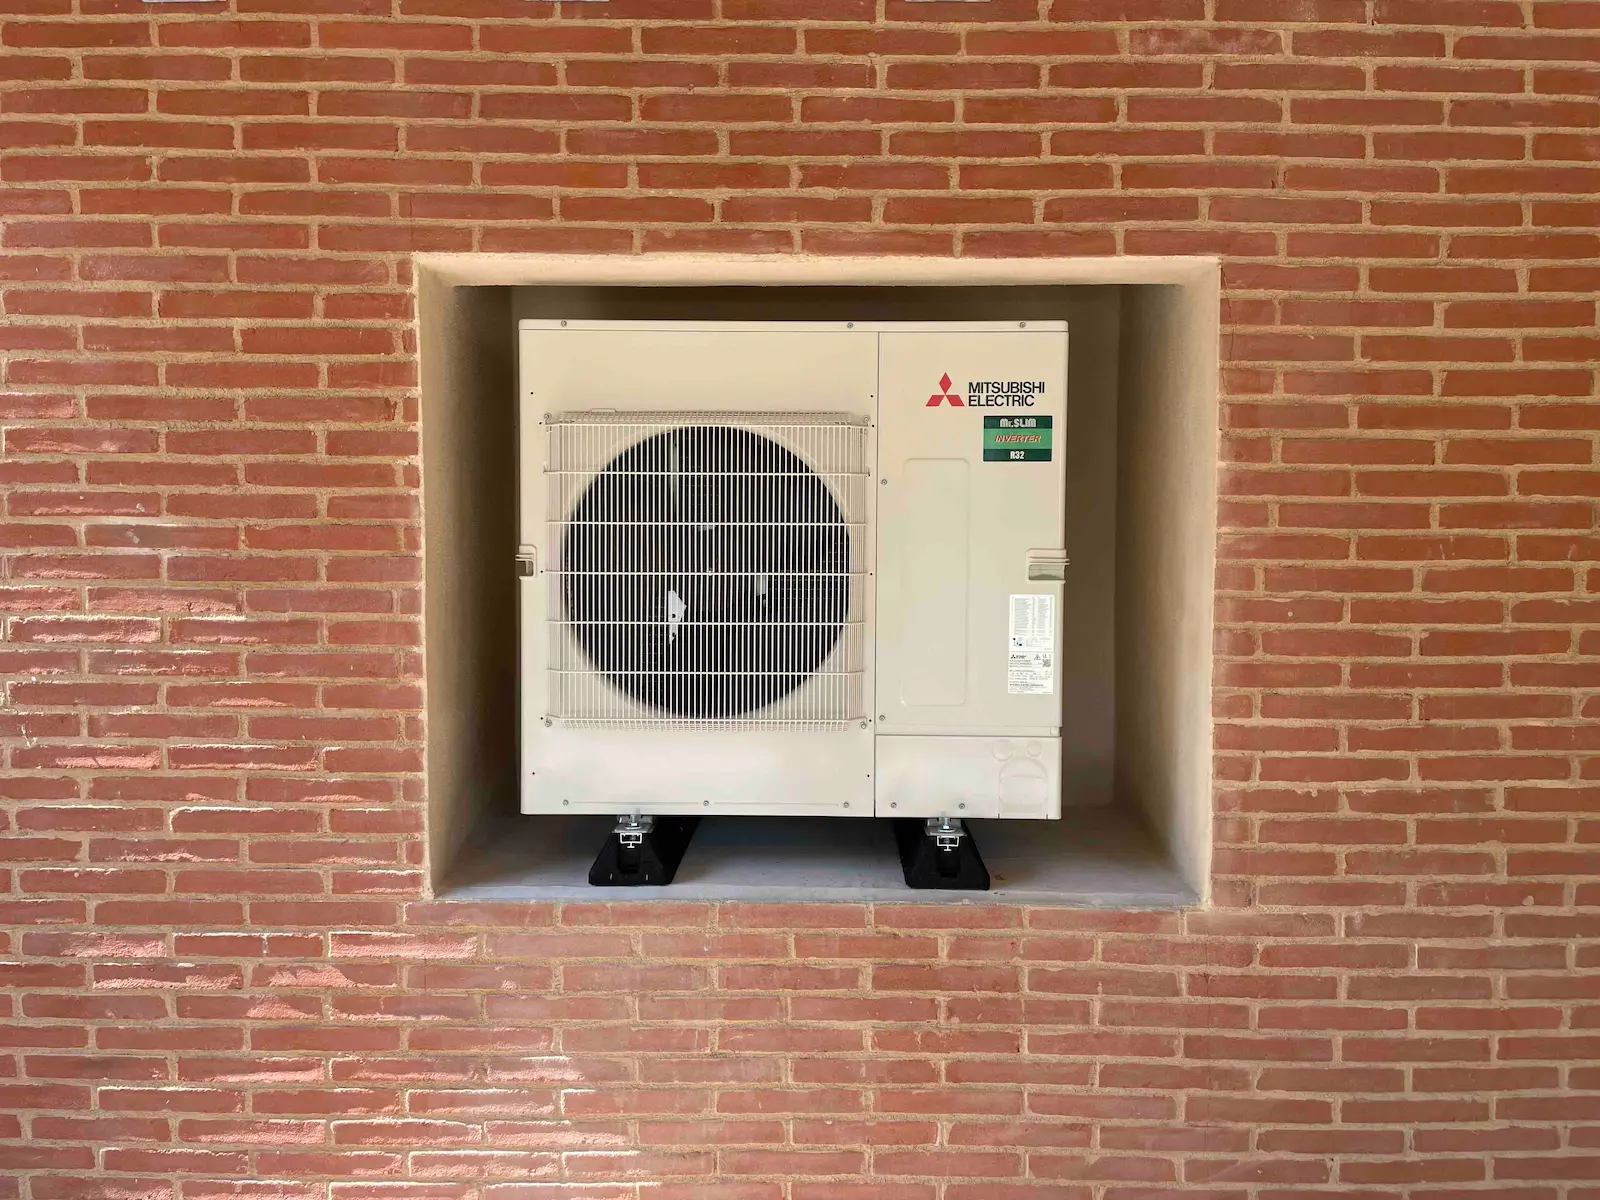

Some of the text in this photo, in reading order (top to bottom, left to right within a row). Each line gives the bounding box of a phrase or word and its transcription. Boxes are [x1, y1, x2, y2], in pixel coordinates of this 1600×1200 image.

[968, 381, 1045, 394] MITSUBISHI
[968, 394, 1035, 407] ELECTRIC
[995, 434, 1041, 443] INVERTER
[1010, 451, 1025, 460] R32
